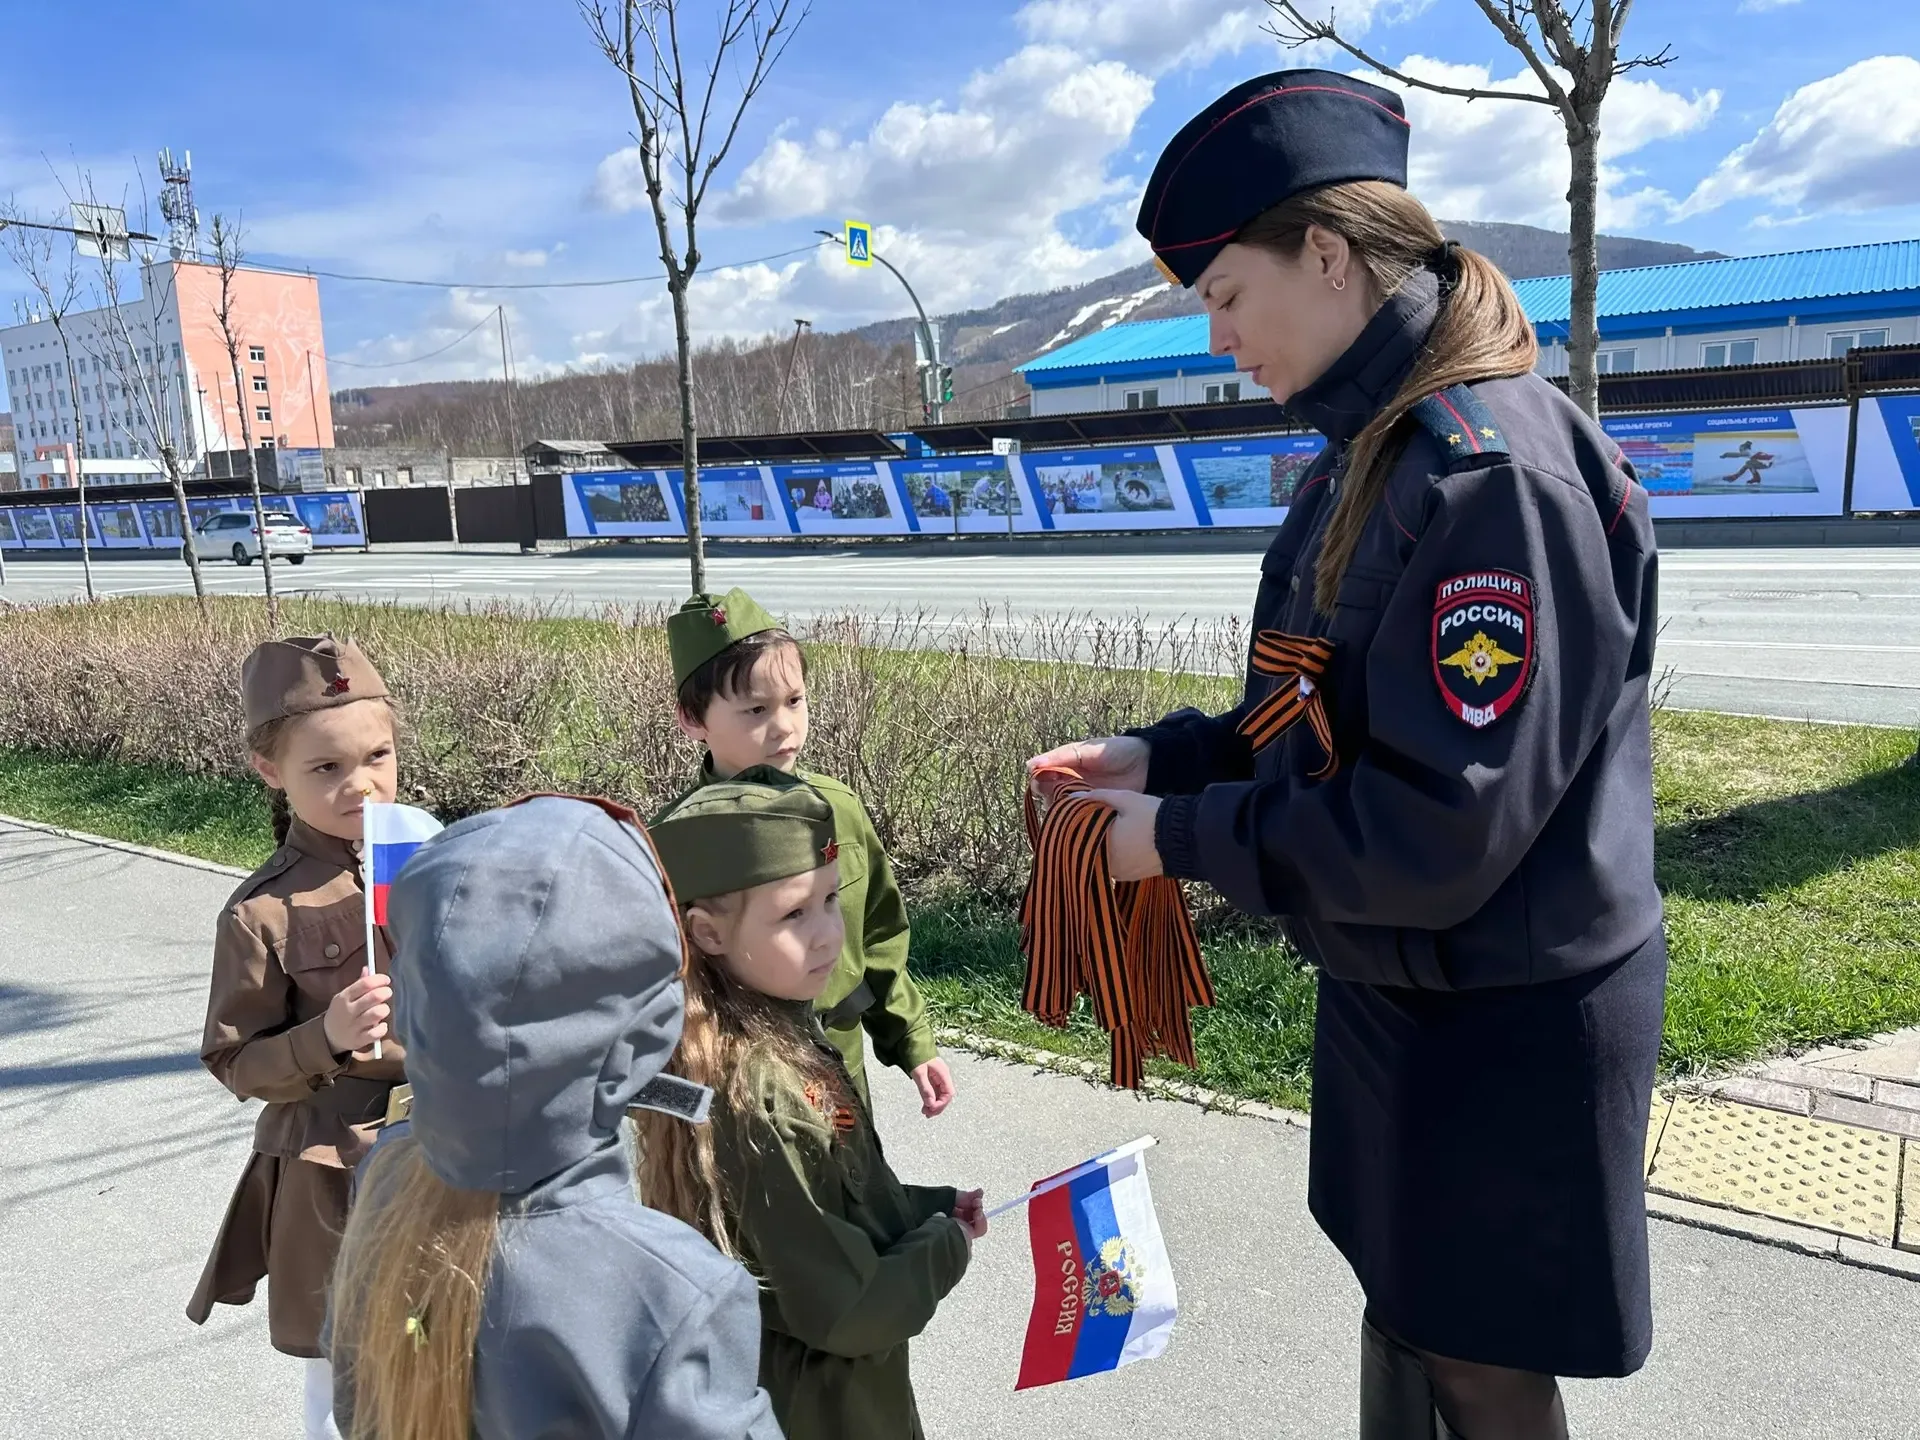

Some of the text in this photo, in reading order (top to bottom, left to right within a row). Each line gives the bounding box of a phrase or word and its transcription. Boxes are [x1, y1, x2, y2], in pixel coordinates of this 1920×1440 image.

[1442, 575, 1522, 599] ПОЛИЦИЯ
[1440, 605, 1524, 637] РОССИЯ
[1461, 703, 1497, 728] МВД
[1053, 1240, 1079, 1336] РОССИЯ
